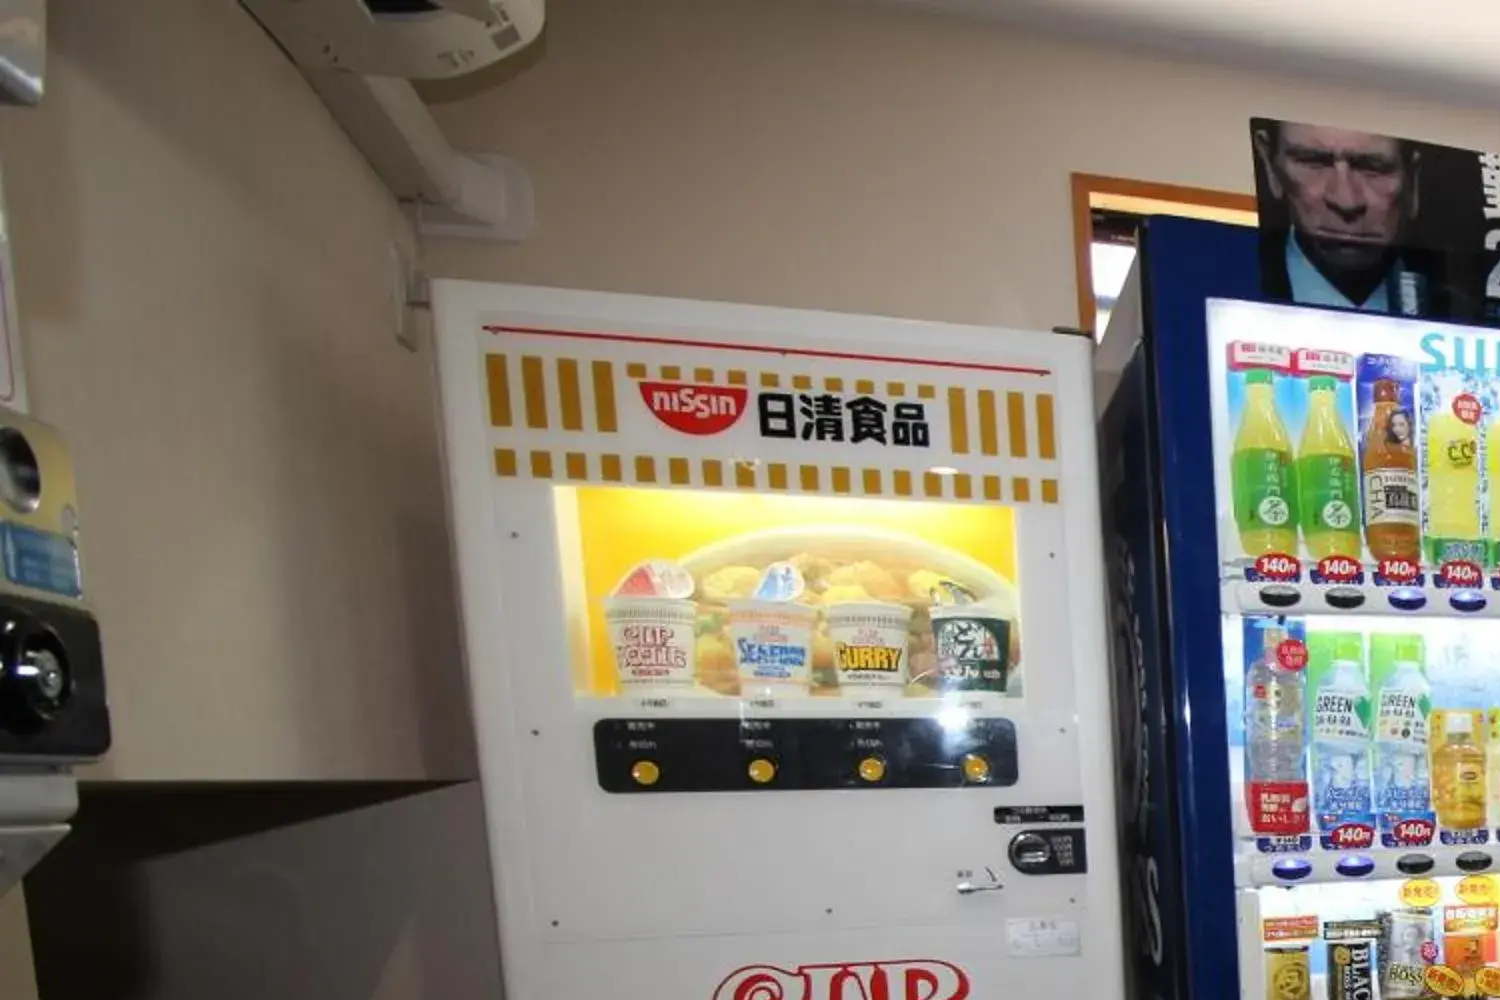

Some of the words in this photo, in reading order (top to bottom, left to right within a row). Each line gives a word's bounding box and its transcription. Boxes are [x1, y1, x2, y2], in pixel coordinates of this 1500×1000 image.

[757, 393, 931, 448] 日清食品
[838, 643, 901, 671] CURRY
